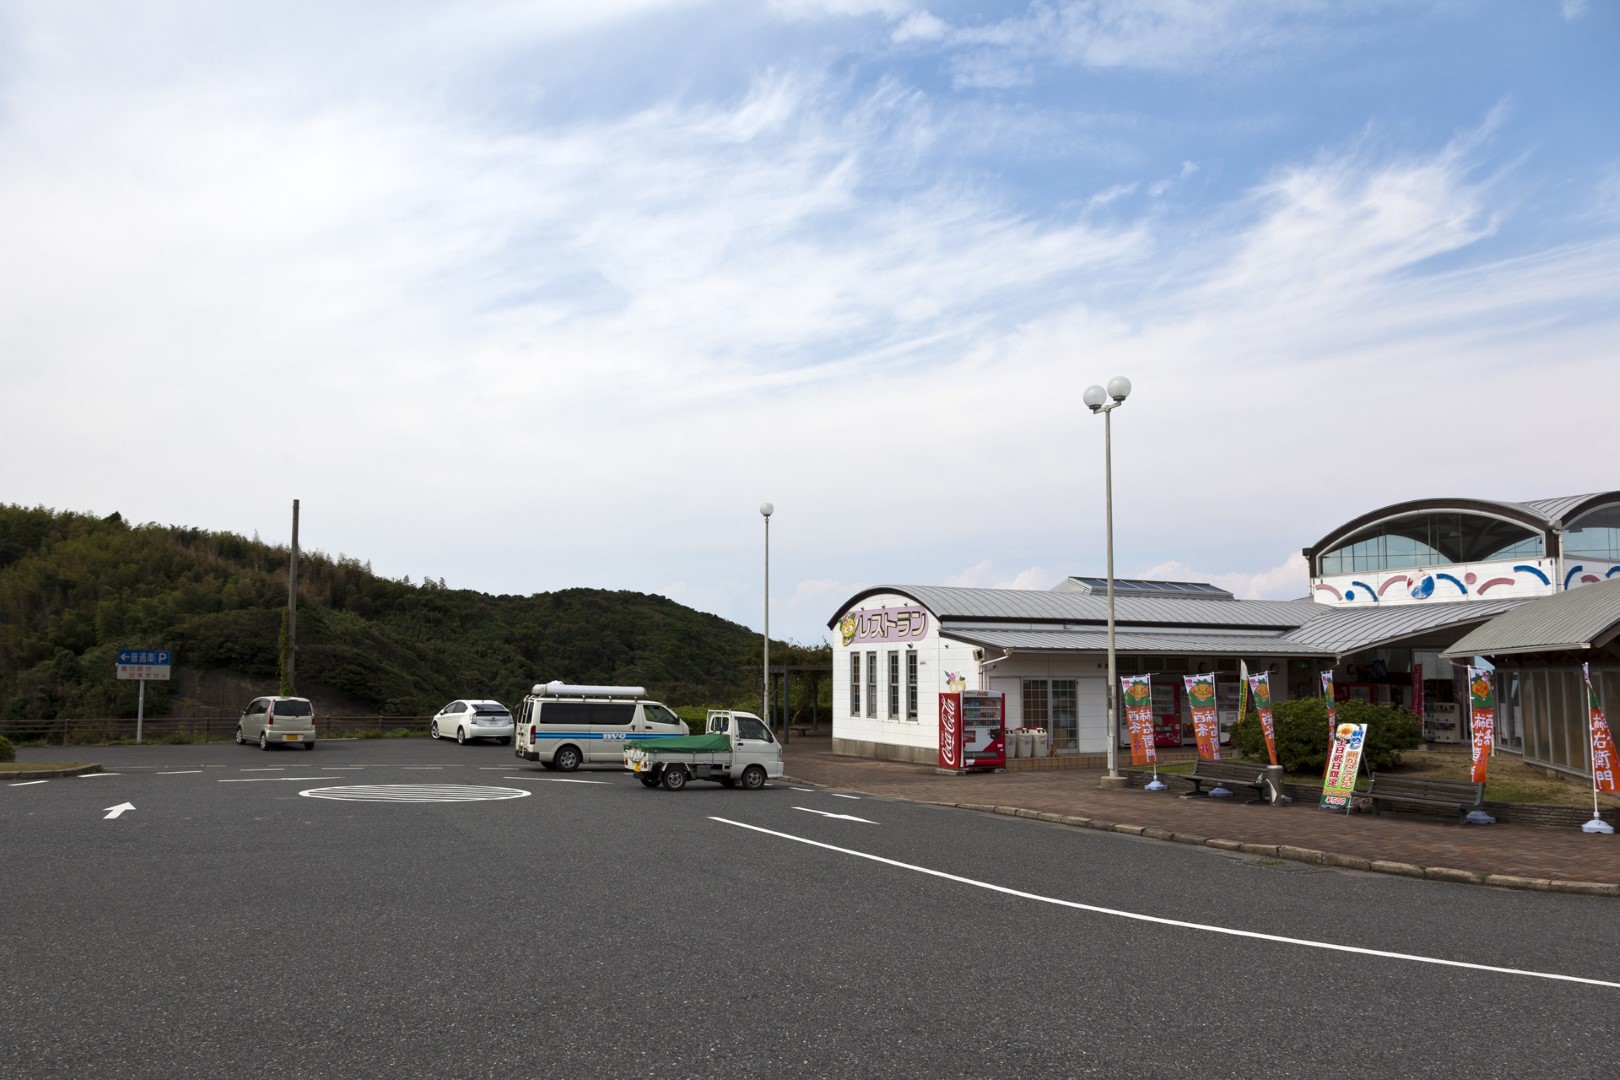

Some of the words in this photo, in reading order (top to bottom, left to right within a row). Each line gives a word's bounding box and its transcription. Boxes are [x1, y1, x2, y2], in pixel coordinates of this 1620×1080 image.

[858, 611, 926, 638] レストラン
[158, 652, 167, 663] P
[941, 695, 955, 765] Coca-Cola
[1593, 713, 1615, 790] 柿右衛門
[1327, 738, 1347, 787] 土日祝日限定
